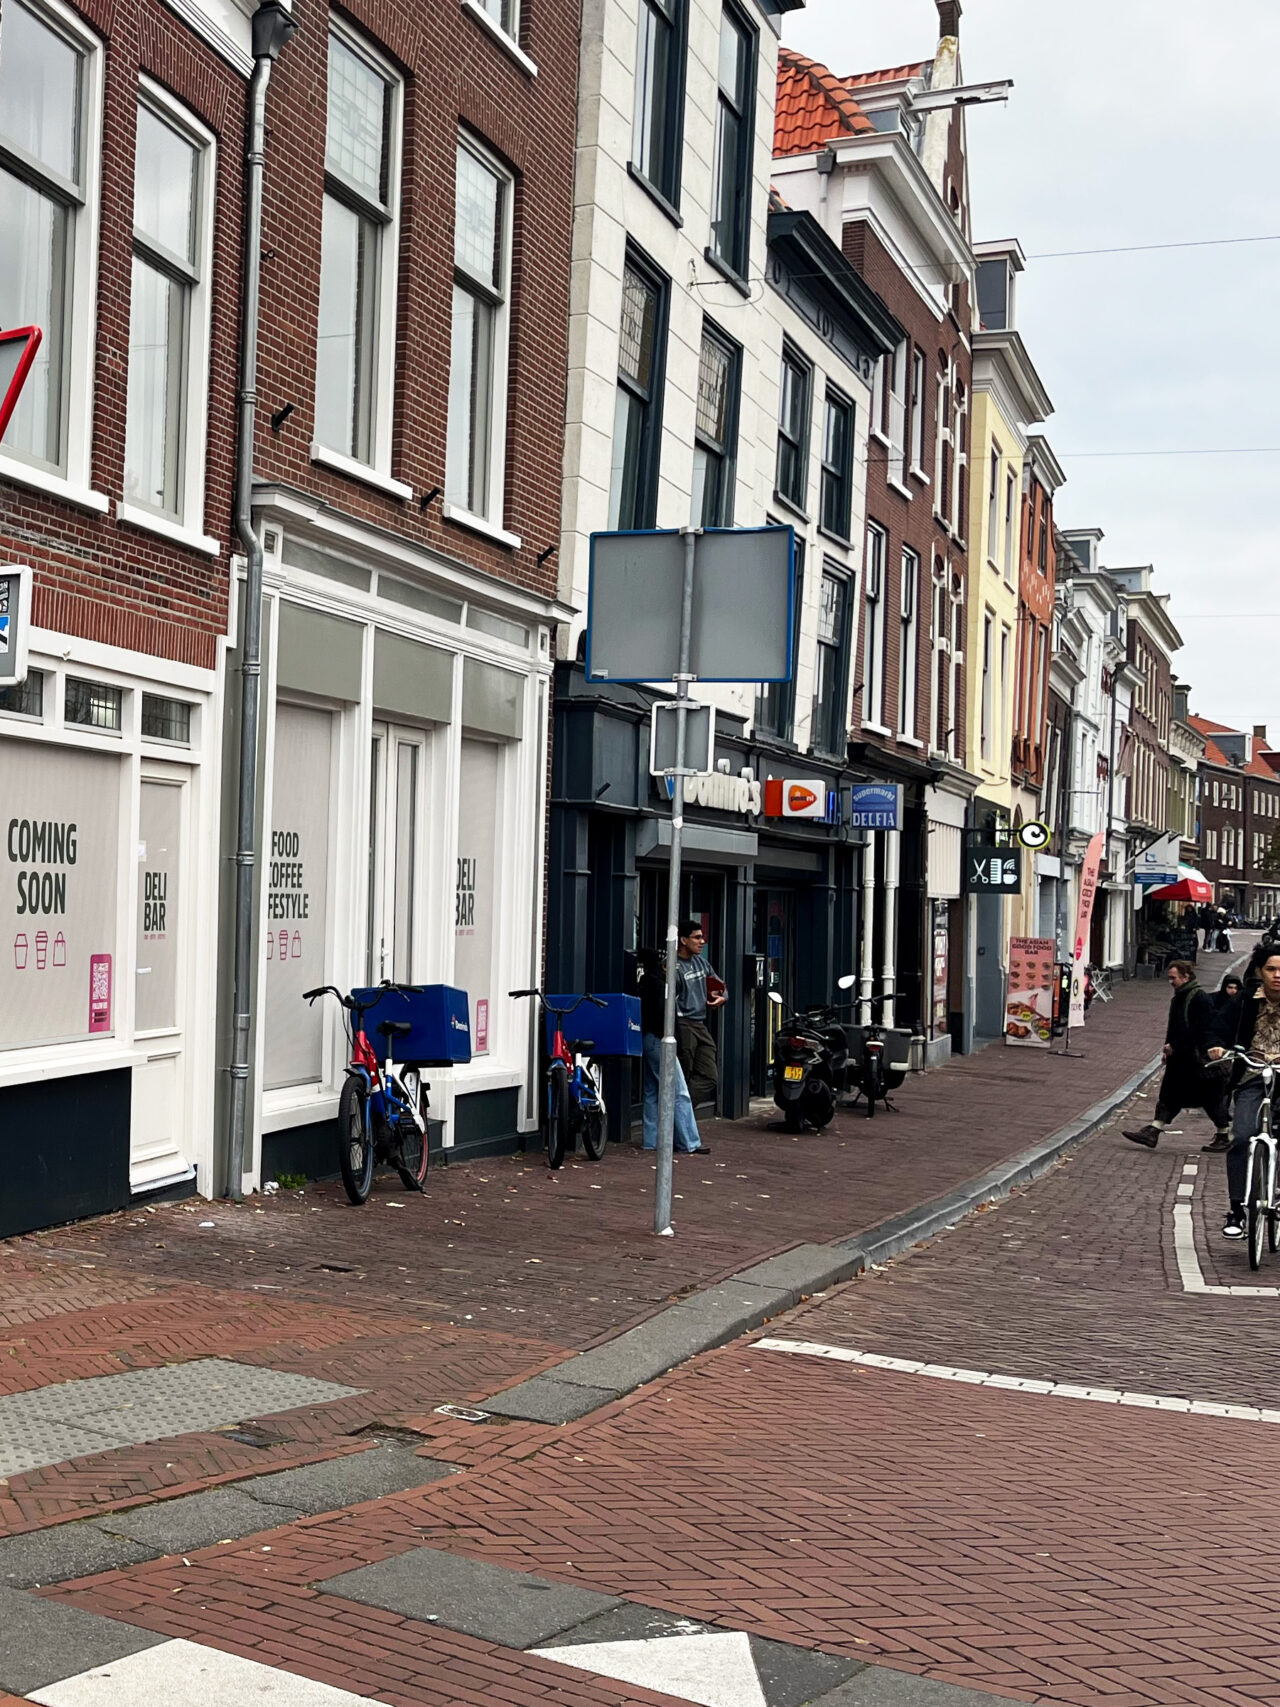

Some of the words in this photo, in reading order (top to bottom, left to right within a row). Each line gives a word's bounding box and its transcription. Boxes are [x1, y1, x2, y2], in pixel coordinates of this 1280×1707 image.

[852, 811, 896, 827] DELFIA
[7, 818, 77, 865] COMING
[271, 831, 300, 858] FOOD
[16, 870, 66, 915] SOON
[144, 872, 167, 901] DELI
[143, 902, 166, 932] BAR
